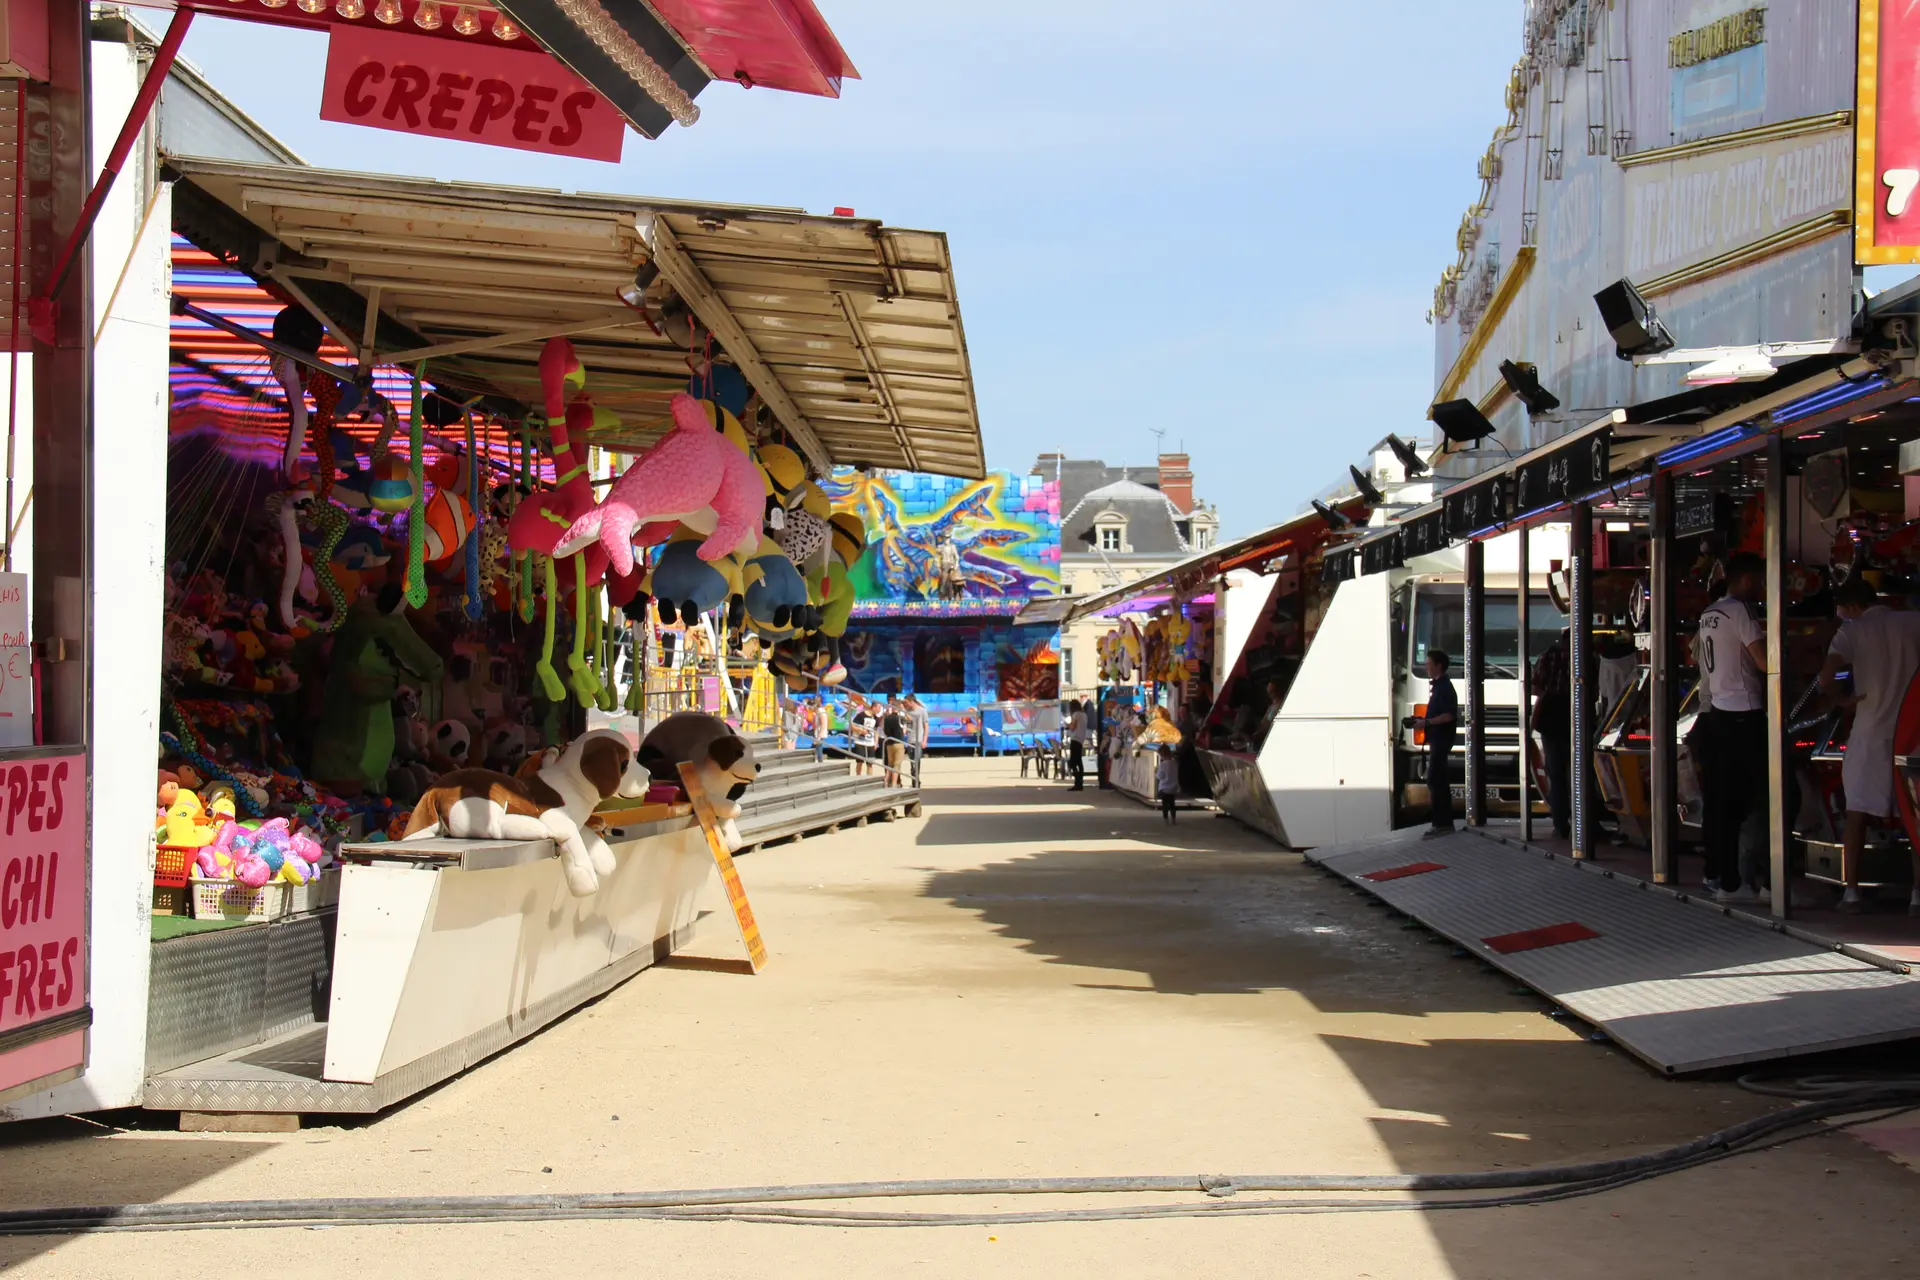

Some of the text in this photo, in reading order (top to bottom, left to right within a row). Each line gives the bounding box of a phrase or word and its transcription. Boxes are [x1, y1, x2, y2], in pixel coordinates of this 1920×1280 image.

[343, 61, 596, 147] CREPES
[1628, 168, 1719, 273] ATLANTIC
[1882, 168, 1920, 217] 7
[0, 762, 68, 836] PES
[1, 851, 58, 930] CHI
